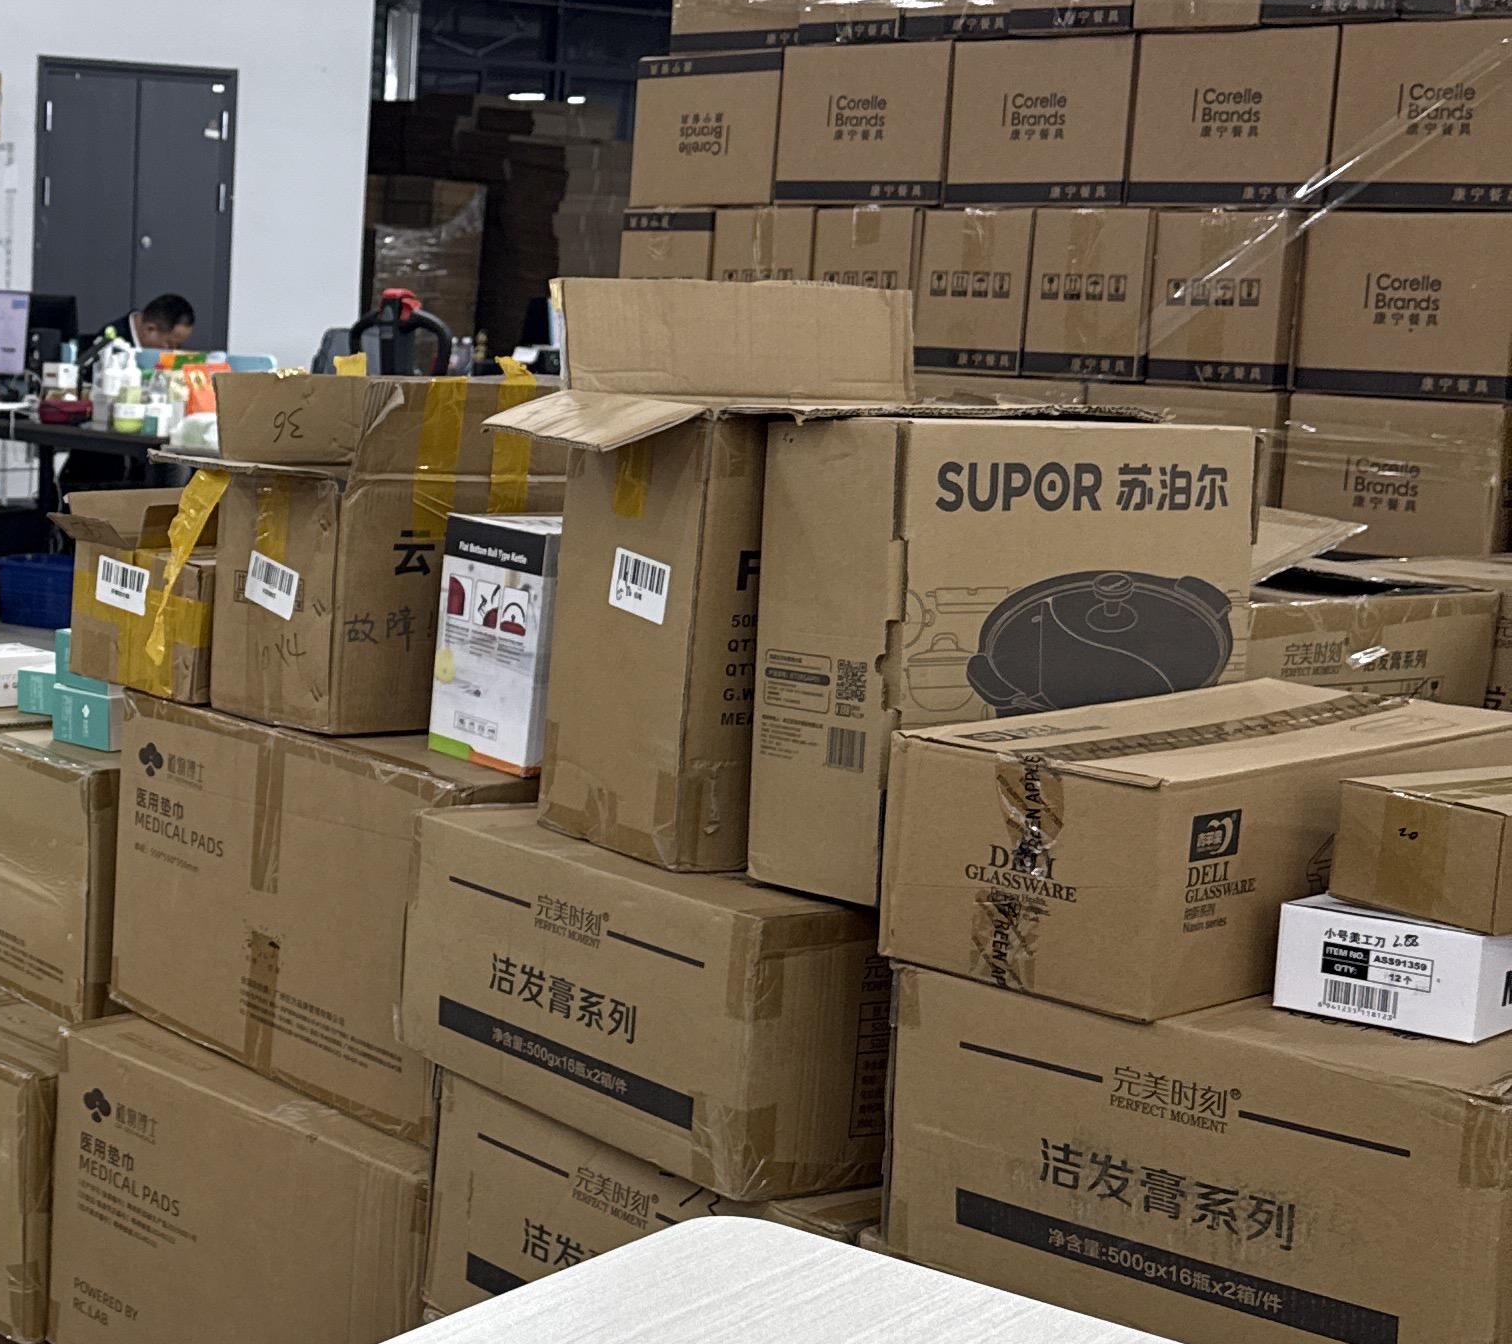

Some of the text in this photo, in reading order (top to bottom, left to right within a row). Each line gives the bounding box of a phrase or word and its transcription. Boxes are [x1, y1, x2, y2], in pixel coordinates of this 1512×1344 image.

[836, 94, 888, 111] Corelle
[1011, 93, 1067, 109] Corelle
[1203, 88, 1262, 105] Corelle
[1409, 82, 1476, 101] Corelle
[834, 112, 886, 129] Brands
[1011, 111, 1065, 127] Brands
[1201, 107, 1260, 124] Brands
[1376, 273, 1442, 292] Corelle
[1374, 293, 1440, 312] Brands
[935, 461, 1229, 513] SUPOR 苏泊尔
[1354, 476, 1418, 497] Brands
[393, 529, 436, 577] 云
[135, 787, 184, 820] 医用垫巾
[134, 809, 190, 846] MEDICAL
[190, 830, 225, 858] PADS
[965, 863, 1077, 903] GLASSWARE
[1185, 861, 1230, 888] DELI
[1185, 878, 1256, 904] GLASSWARE
[536, 894, 602, 937] 完美时刻
[534, 917, 601, 949] PERFECT MOMENT
[1324, 928, 1386, 948] 小号美工刀
[1325, 946, 1349, 958] ITEM
[489, 952, 637, 1044] 洁发膏系列
[1112, 1066, 1228, 1119] 完美时刻
[1110, 1094, 1228, 1135] PERFECT MOMENT
[80, 1131, 135, 1172] 医用垫巾
[79, 1154, 139, 1199] MEDICAL
[142, 1185, 181, 1217] PADS
[575, 1166, 650, 1218] 完美时刻
[1039, 1137, 1296, 1252] 洁发膏系列
[572, 1188, 649, 1230] PERFECT MOMENT
[521, 1218, 600, 1269] 洁发
[74, 1277, 139, 1322] POWERED BY
